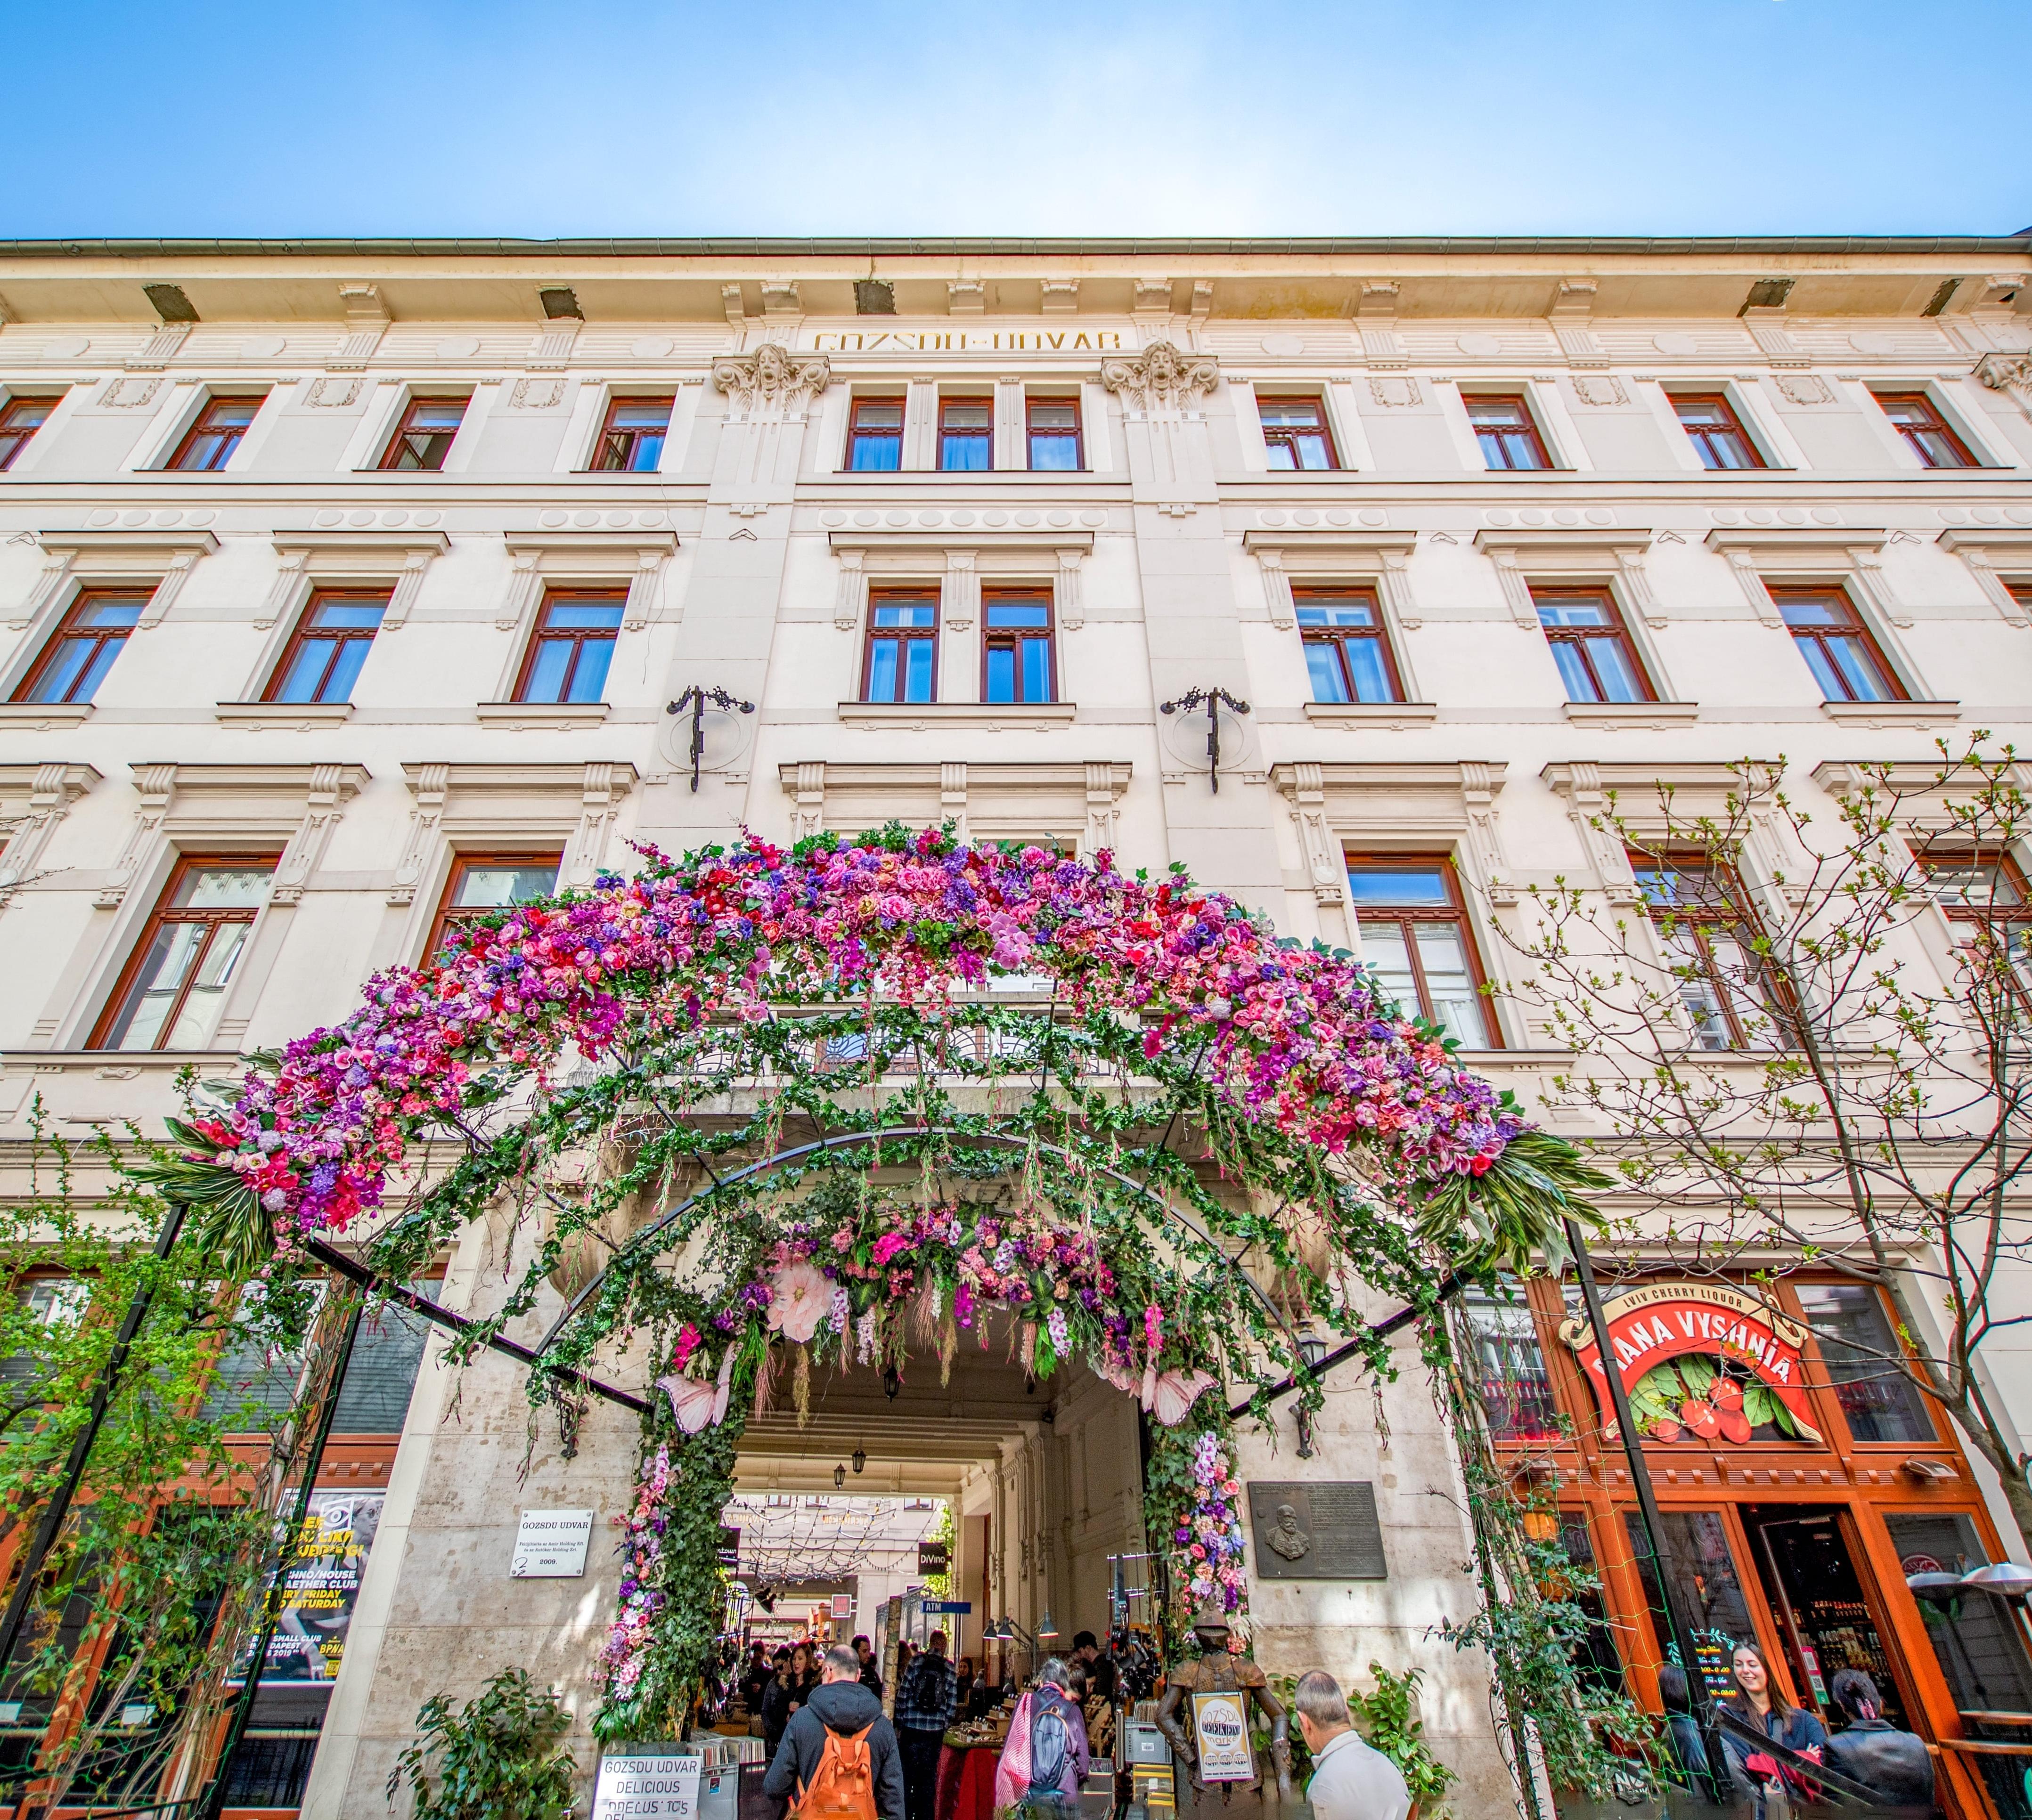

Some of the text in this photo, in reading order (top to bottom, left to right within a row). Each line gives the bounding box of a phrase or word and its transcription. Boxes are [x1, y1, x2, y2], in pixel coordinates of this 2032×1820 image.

[1623, 1287, 1742, 1308] LVIV CHERRY LIQUOR
[1591, 1315, 1676, 1375] PANA
[285, 1580, 327, 1589] AETHER
[329, 1580, 358, 1589] CLUB
[264, 1590, 343, 1599] EERY FRIDAY
[262, 1599, 346, 1609] AD SATURDAY
[926, 1602, 941, 1611] ATM
[605, 1761, 697, 1773] GOZSDU UDVAR
[616, 1780, 680, 1794] DELICIOUS
